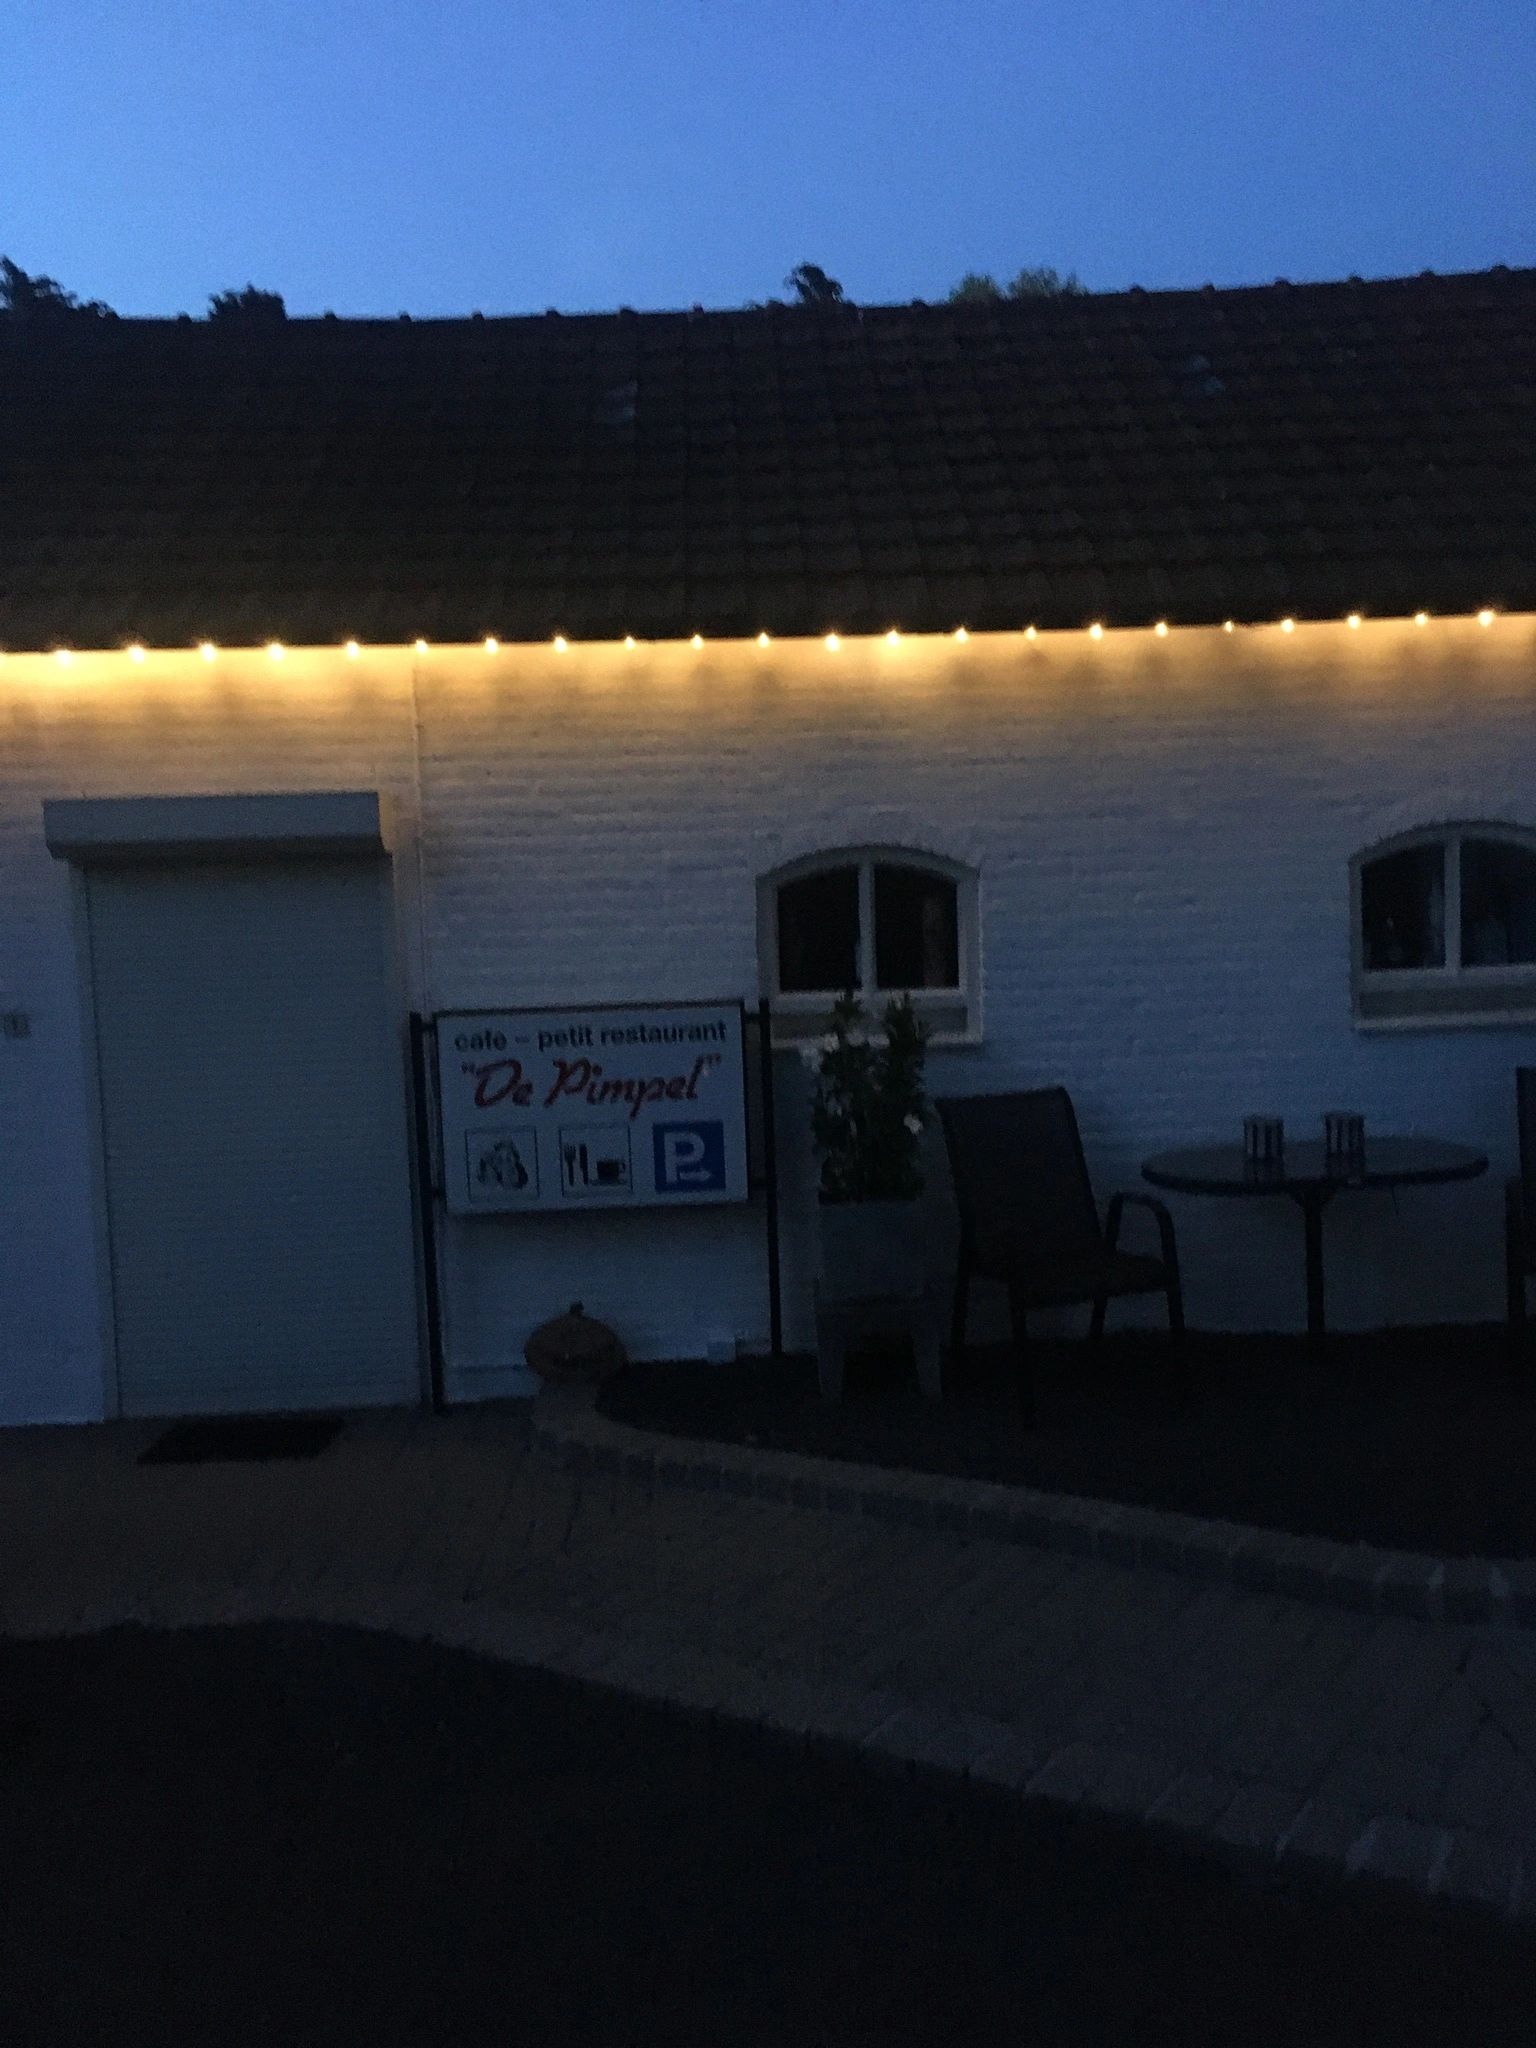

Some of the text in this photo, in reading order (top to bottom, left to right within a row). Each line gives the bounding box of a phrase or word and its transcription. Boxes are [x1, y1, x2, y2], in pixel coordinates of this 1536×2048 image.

[538, 1025, 594, 1052] petit
[600, 1020, 727, 1044] restaurant
[663, 1130, 706, 1185] P
